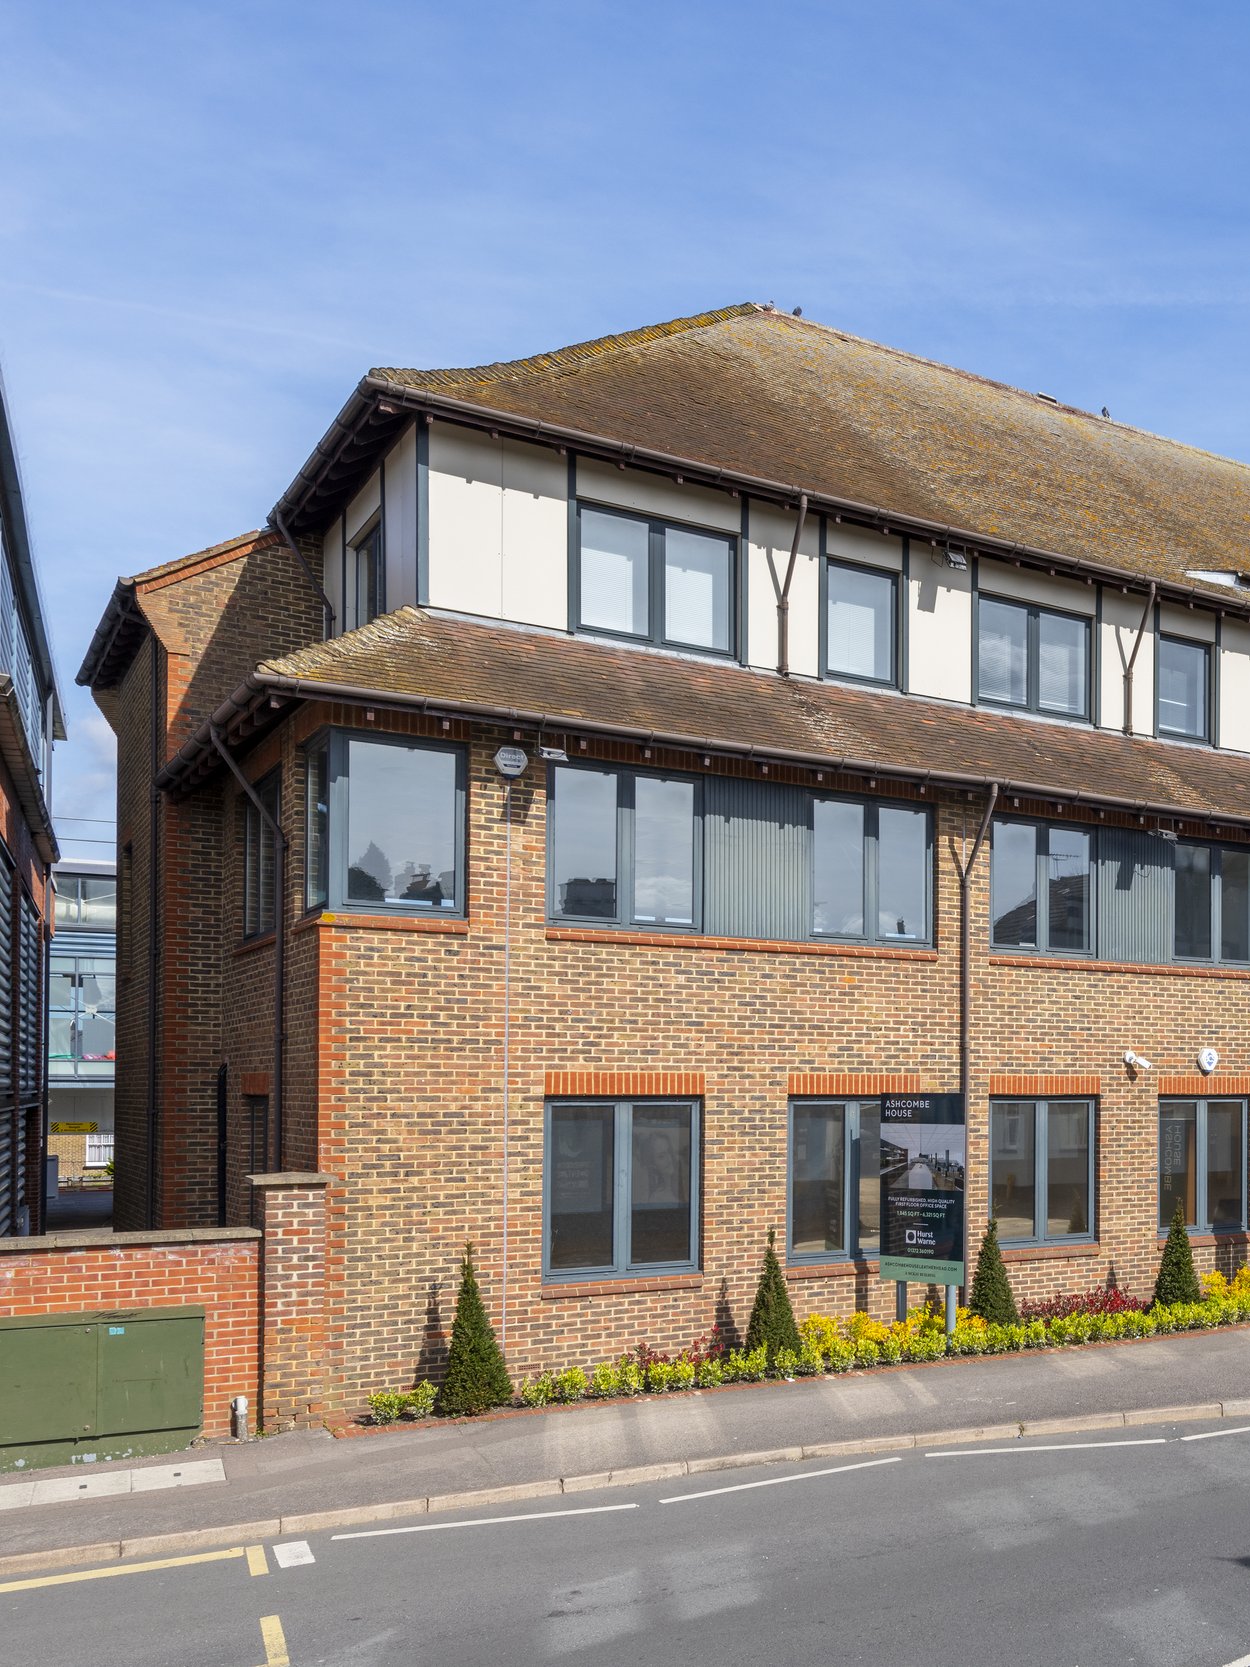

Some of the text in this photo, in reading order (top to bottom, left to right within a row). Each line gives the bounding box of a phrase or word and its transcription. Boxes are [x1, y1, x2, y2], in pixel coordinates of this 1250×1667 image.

[885, 1100, 930, 1108] ASHCOMBE
[885, 1109, 912, 1117] HOUSE
[917, 1230, 933, 1238] Hurst
